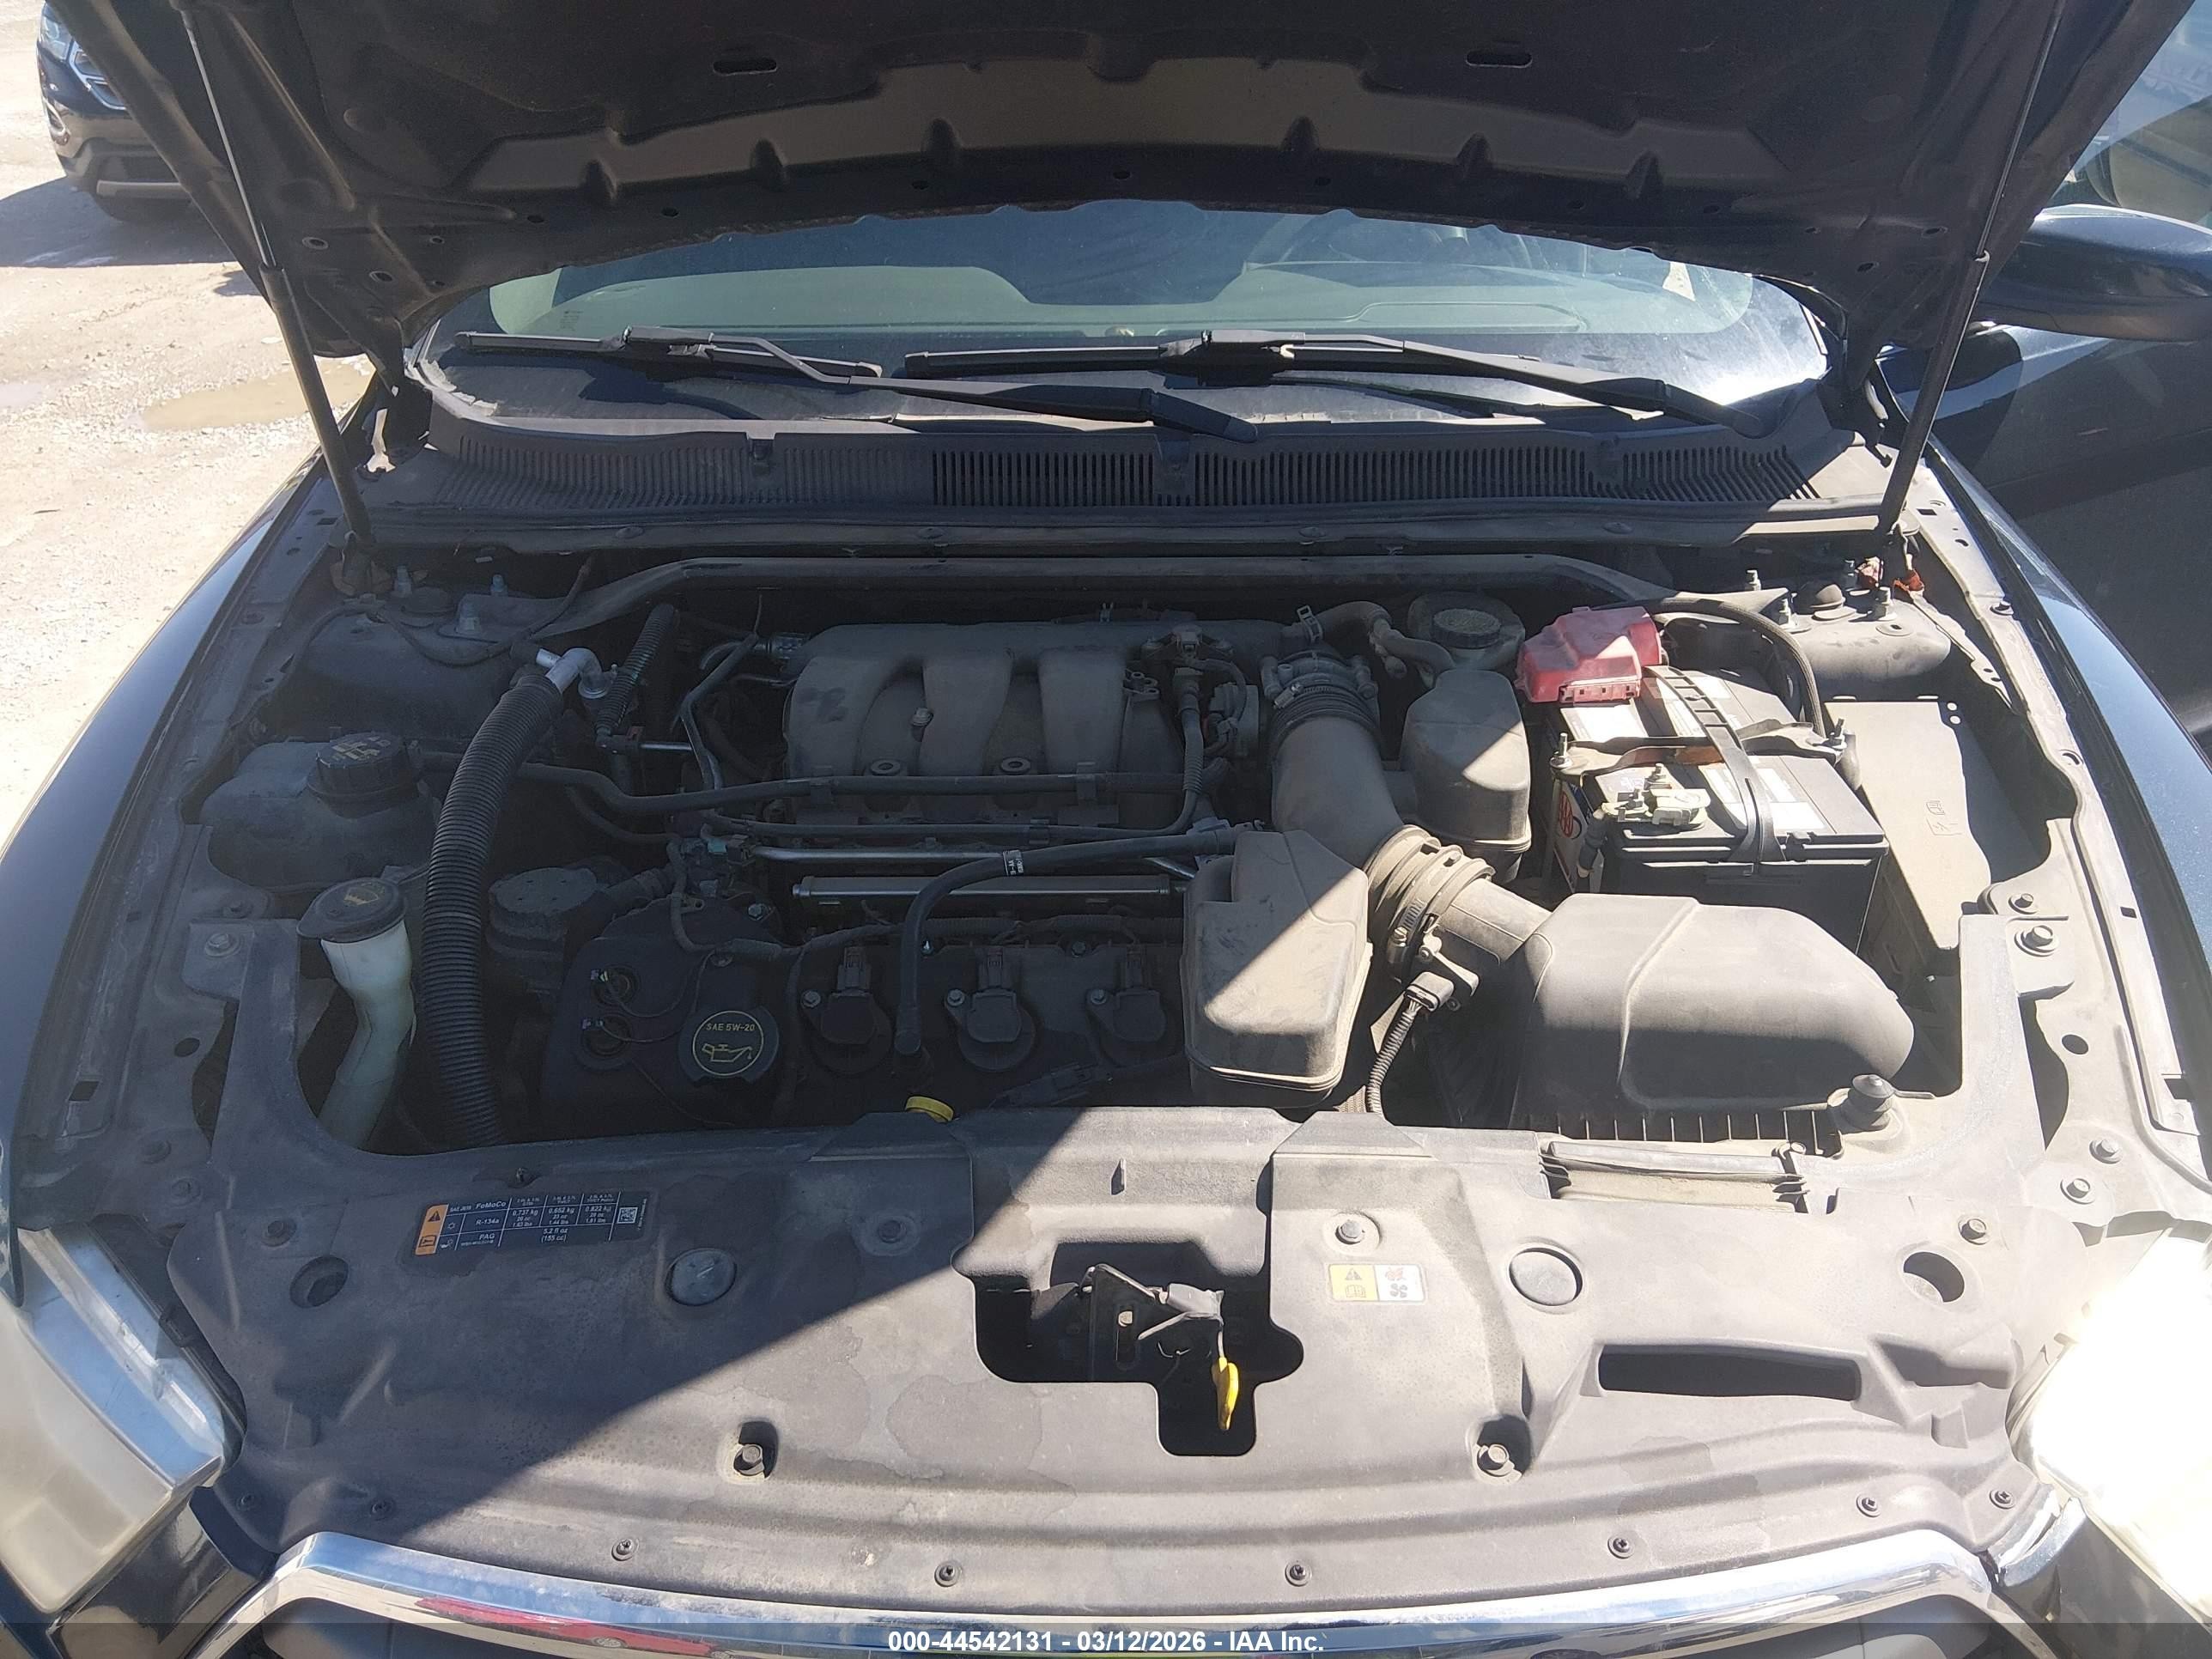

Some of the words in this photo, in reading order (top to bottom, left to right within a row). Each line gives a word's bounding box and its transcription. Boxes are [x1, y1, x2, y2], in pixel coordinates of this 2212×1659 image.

[705, 1023, 724, 1031] SAE
[726, 1023, 756, 1031] 5W-20
[475, 1200, 507, 1209] FoMoCo
